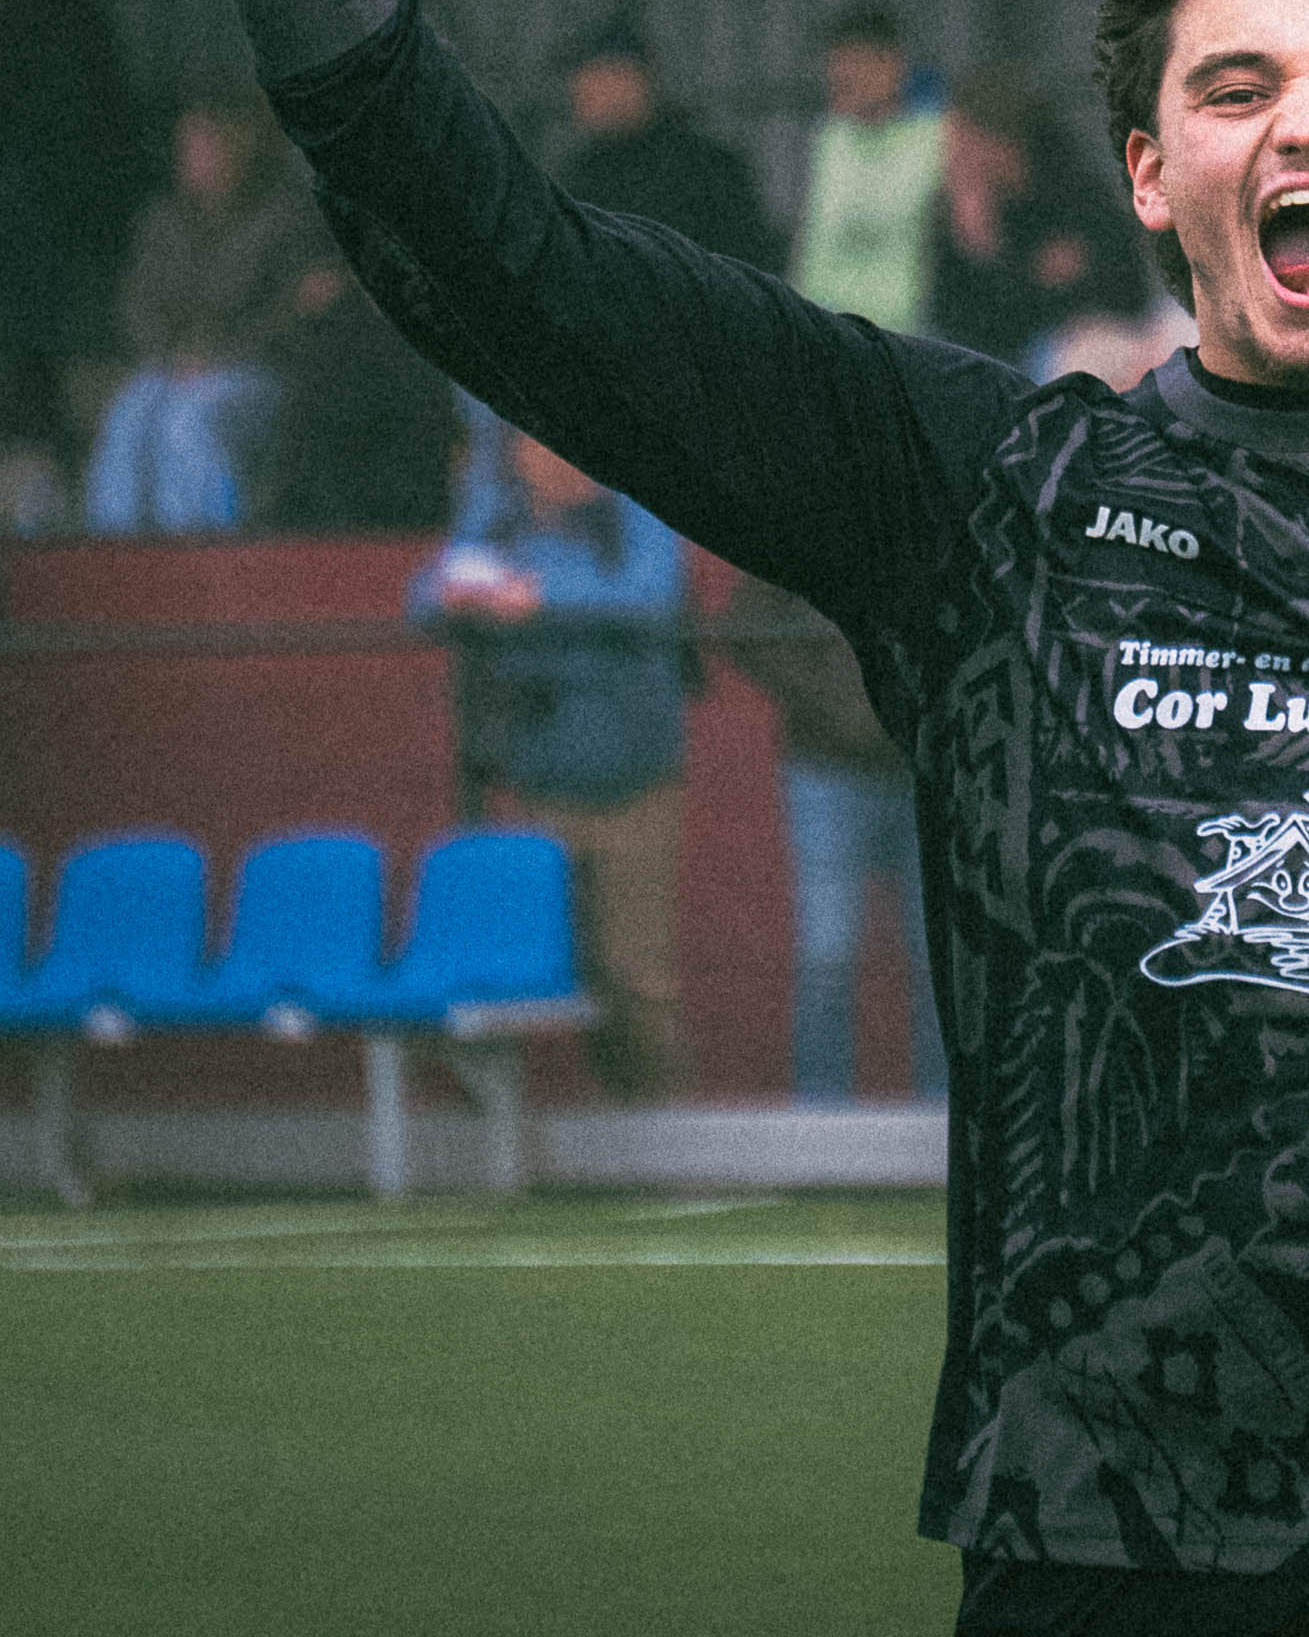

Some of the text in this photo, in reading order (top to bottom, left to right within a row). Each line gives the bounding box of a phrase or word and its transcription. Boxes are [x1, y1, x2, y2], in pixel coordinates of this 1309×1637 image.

[1086, 506, 1200, 560] JAKO
[1119, 639, 1247, 669] Timmer-
[1254, 652, 1291, 671] en
[1113, 677, 1228, 730] Cor
